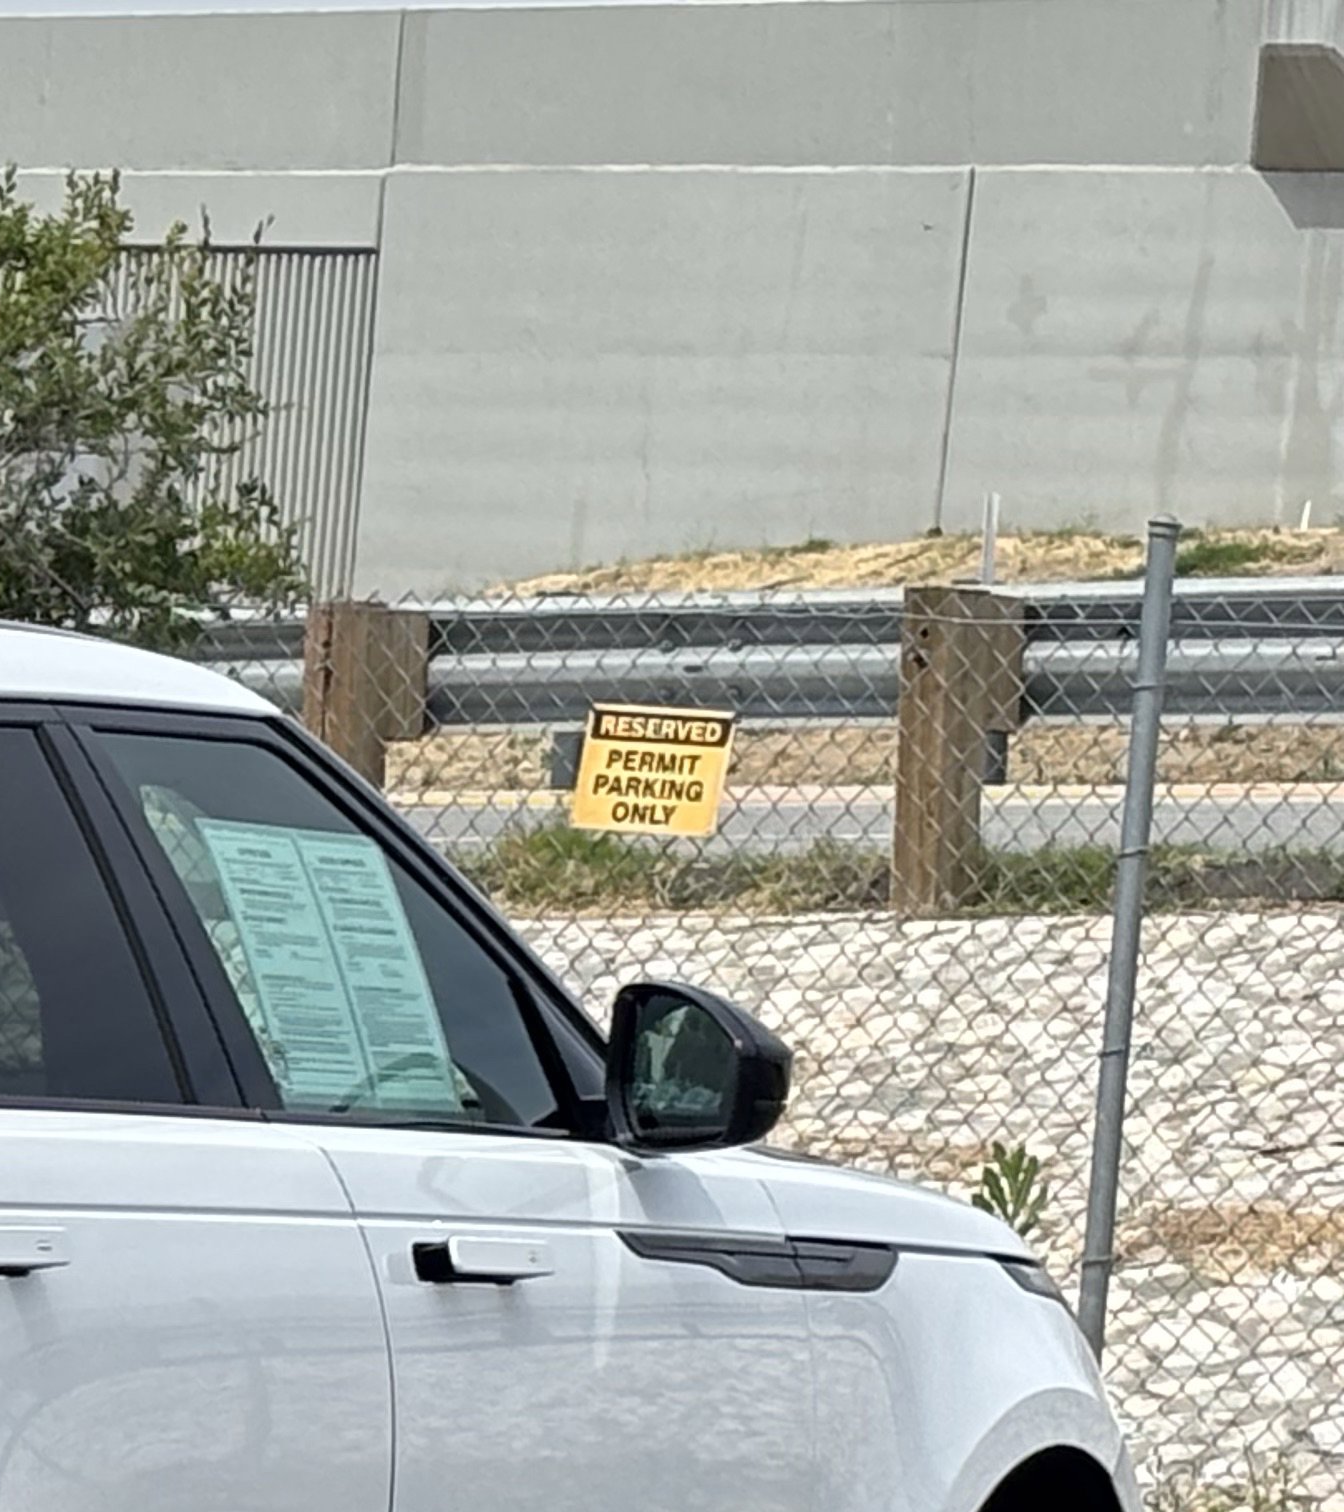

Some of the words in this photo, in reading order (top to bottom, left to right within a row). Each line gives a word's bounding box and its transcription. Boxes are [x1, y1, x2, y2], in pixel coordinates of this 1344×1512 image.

[600, 715, 722, 742] RESERVED
[606, 749, 702, 775] PERMIT
[593, 774, 704, 802] PARKING
[612, 802, 677, 825] ONLY
